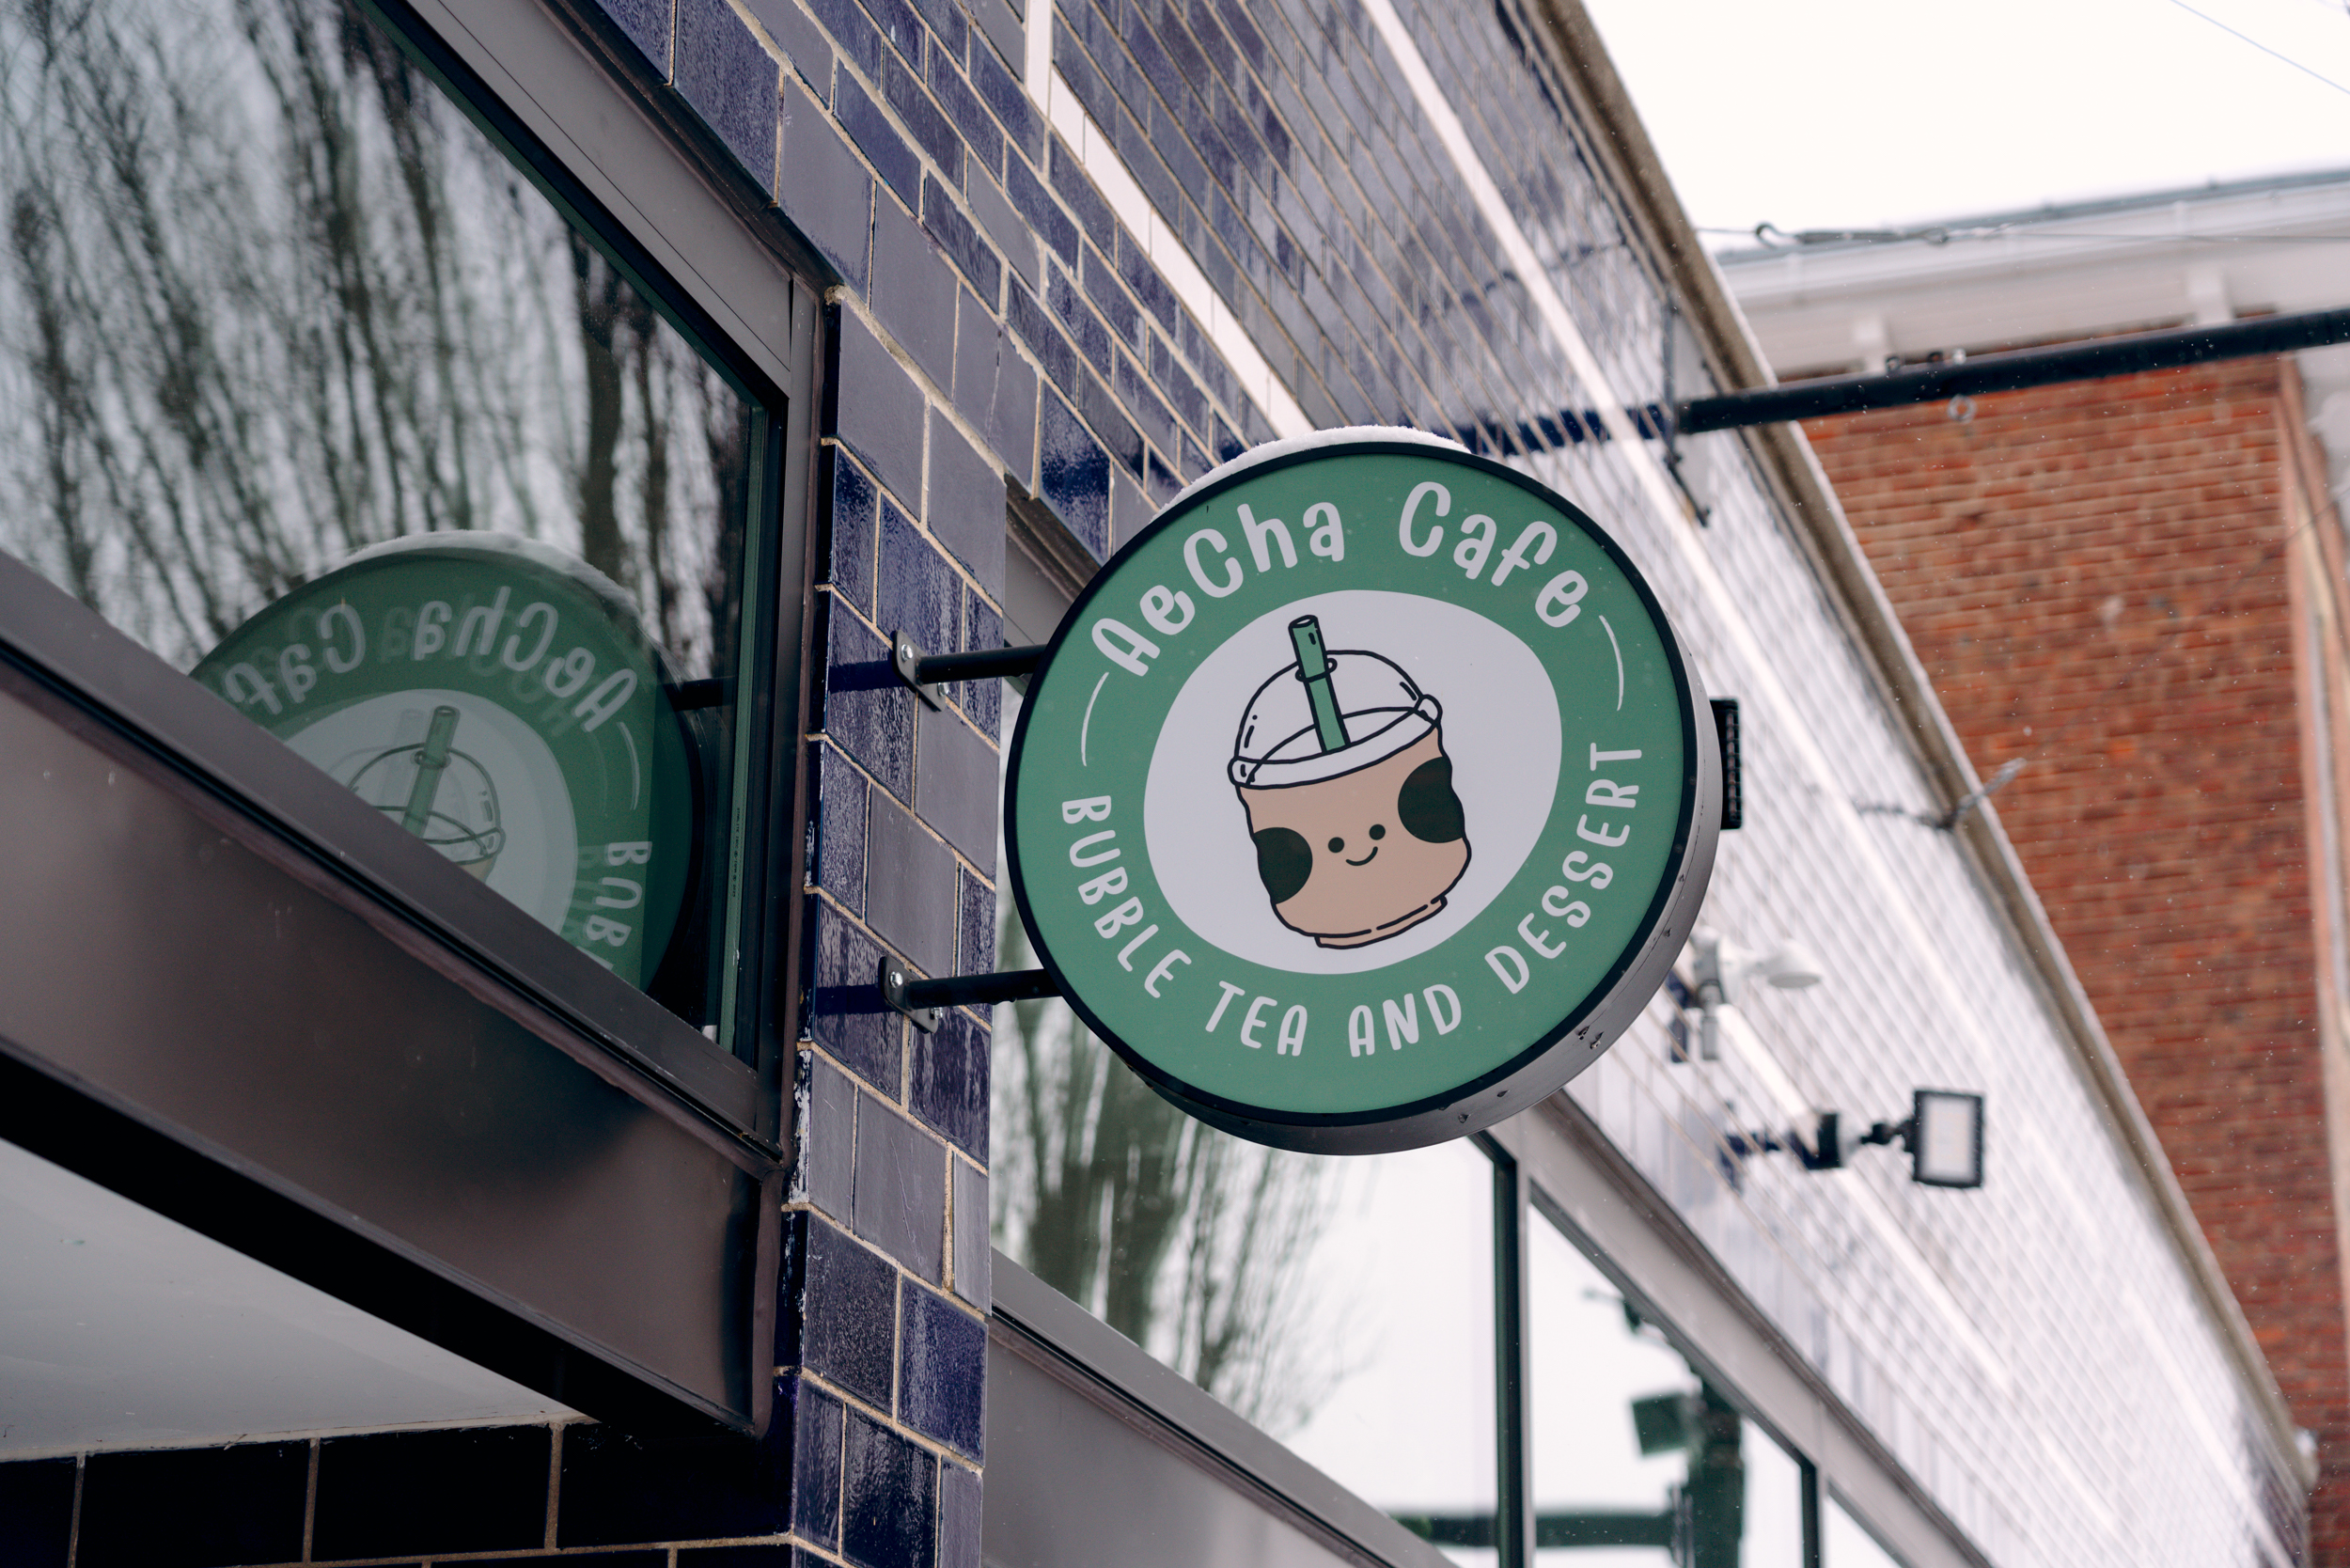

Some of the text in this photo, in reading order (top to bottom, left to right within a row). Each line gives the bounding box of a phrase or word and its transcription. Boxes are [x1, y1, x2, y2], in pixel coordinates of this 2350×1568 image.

[1091, 481, 1589, 677] AeCha Cafe
[1061, 742, 1642, 1058] BUBBLE TEA AND DESSERT
